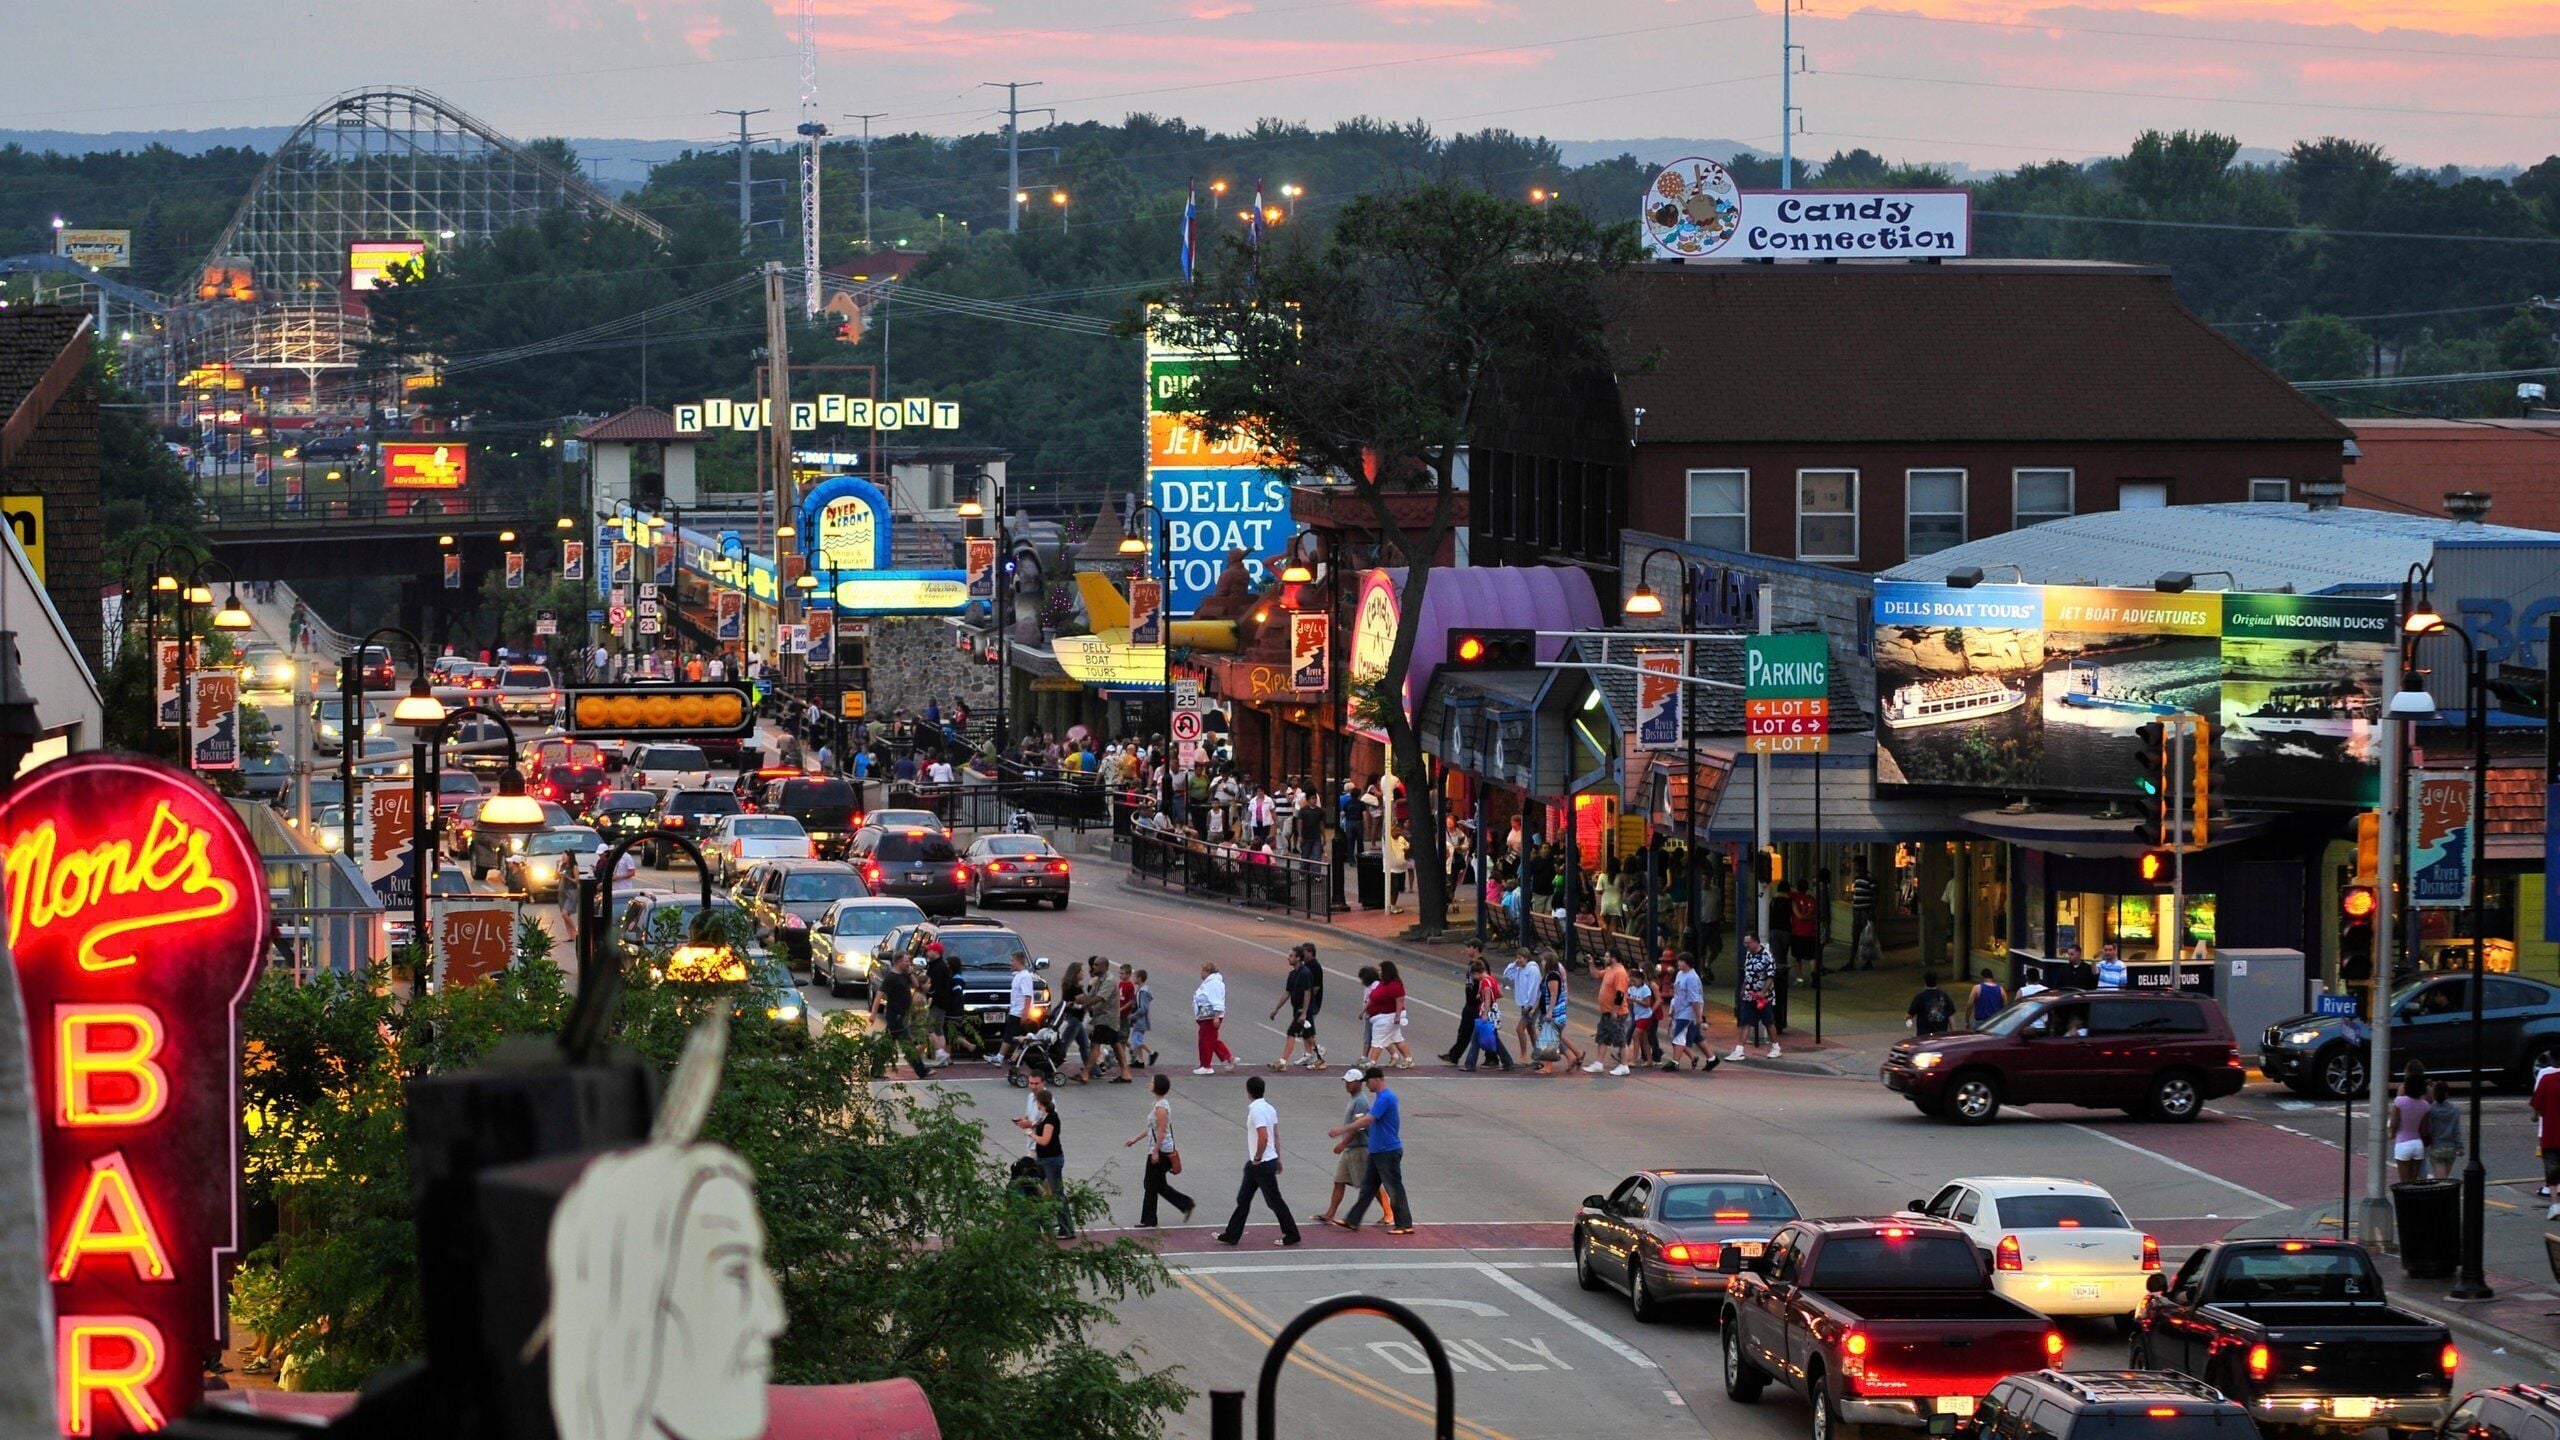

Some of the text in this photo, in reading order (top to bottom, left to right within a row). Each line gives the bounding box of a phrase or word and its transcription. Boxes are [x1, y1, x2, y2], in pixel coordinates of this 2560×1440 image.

[1777, 198, 1914, 224] Candy
[1748, 226, 1956, 251] Connection
[681, 397, 955, 430] RIVRFRONT
[1162, 426, 1201, 455] JET
[1160, 481, 1284, 513] DELLS
[1168, 519, 1272, 551] BOAT
[642, 586, 656, 597] 13
[642, 604, 655, 614] 16
[1885, 601, 2033, 619] DELLS BOAT TOURS
[2059, 606, 2207, 625] JET BOAT ADVENTURES
[641, 621, 656, 631] 23
[2232, 613, 2385, 630] Original WISCONSIN DUCKS
[1083, 642, 1112, 653] DELLS
[1085, 655, 1109, 665] BOAT
[1085, 667, 1116, 677] TOURS
[1177, 695, 1197, 706] 25
[1771, 701, 1821, 716] LOT 5
[1753, 719, 1803, 734] LOT 6
[1771, 737, 1821, 751] LOT 7
[2433, 865, 2460, 881] RIVER
[2137, 974, 2159, 986] DELLS
[2323, 997, 2357, 1015] River
[50, 1003, 175, 1438] BAR
[1365, 1338, 1574, 1375] ONLY
